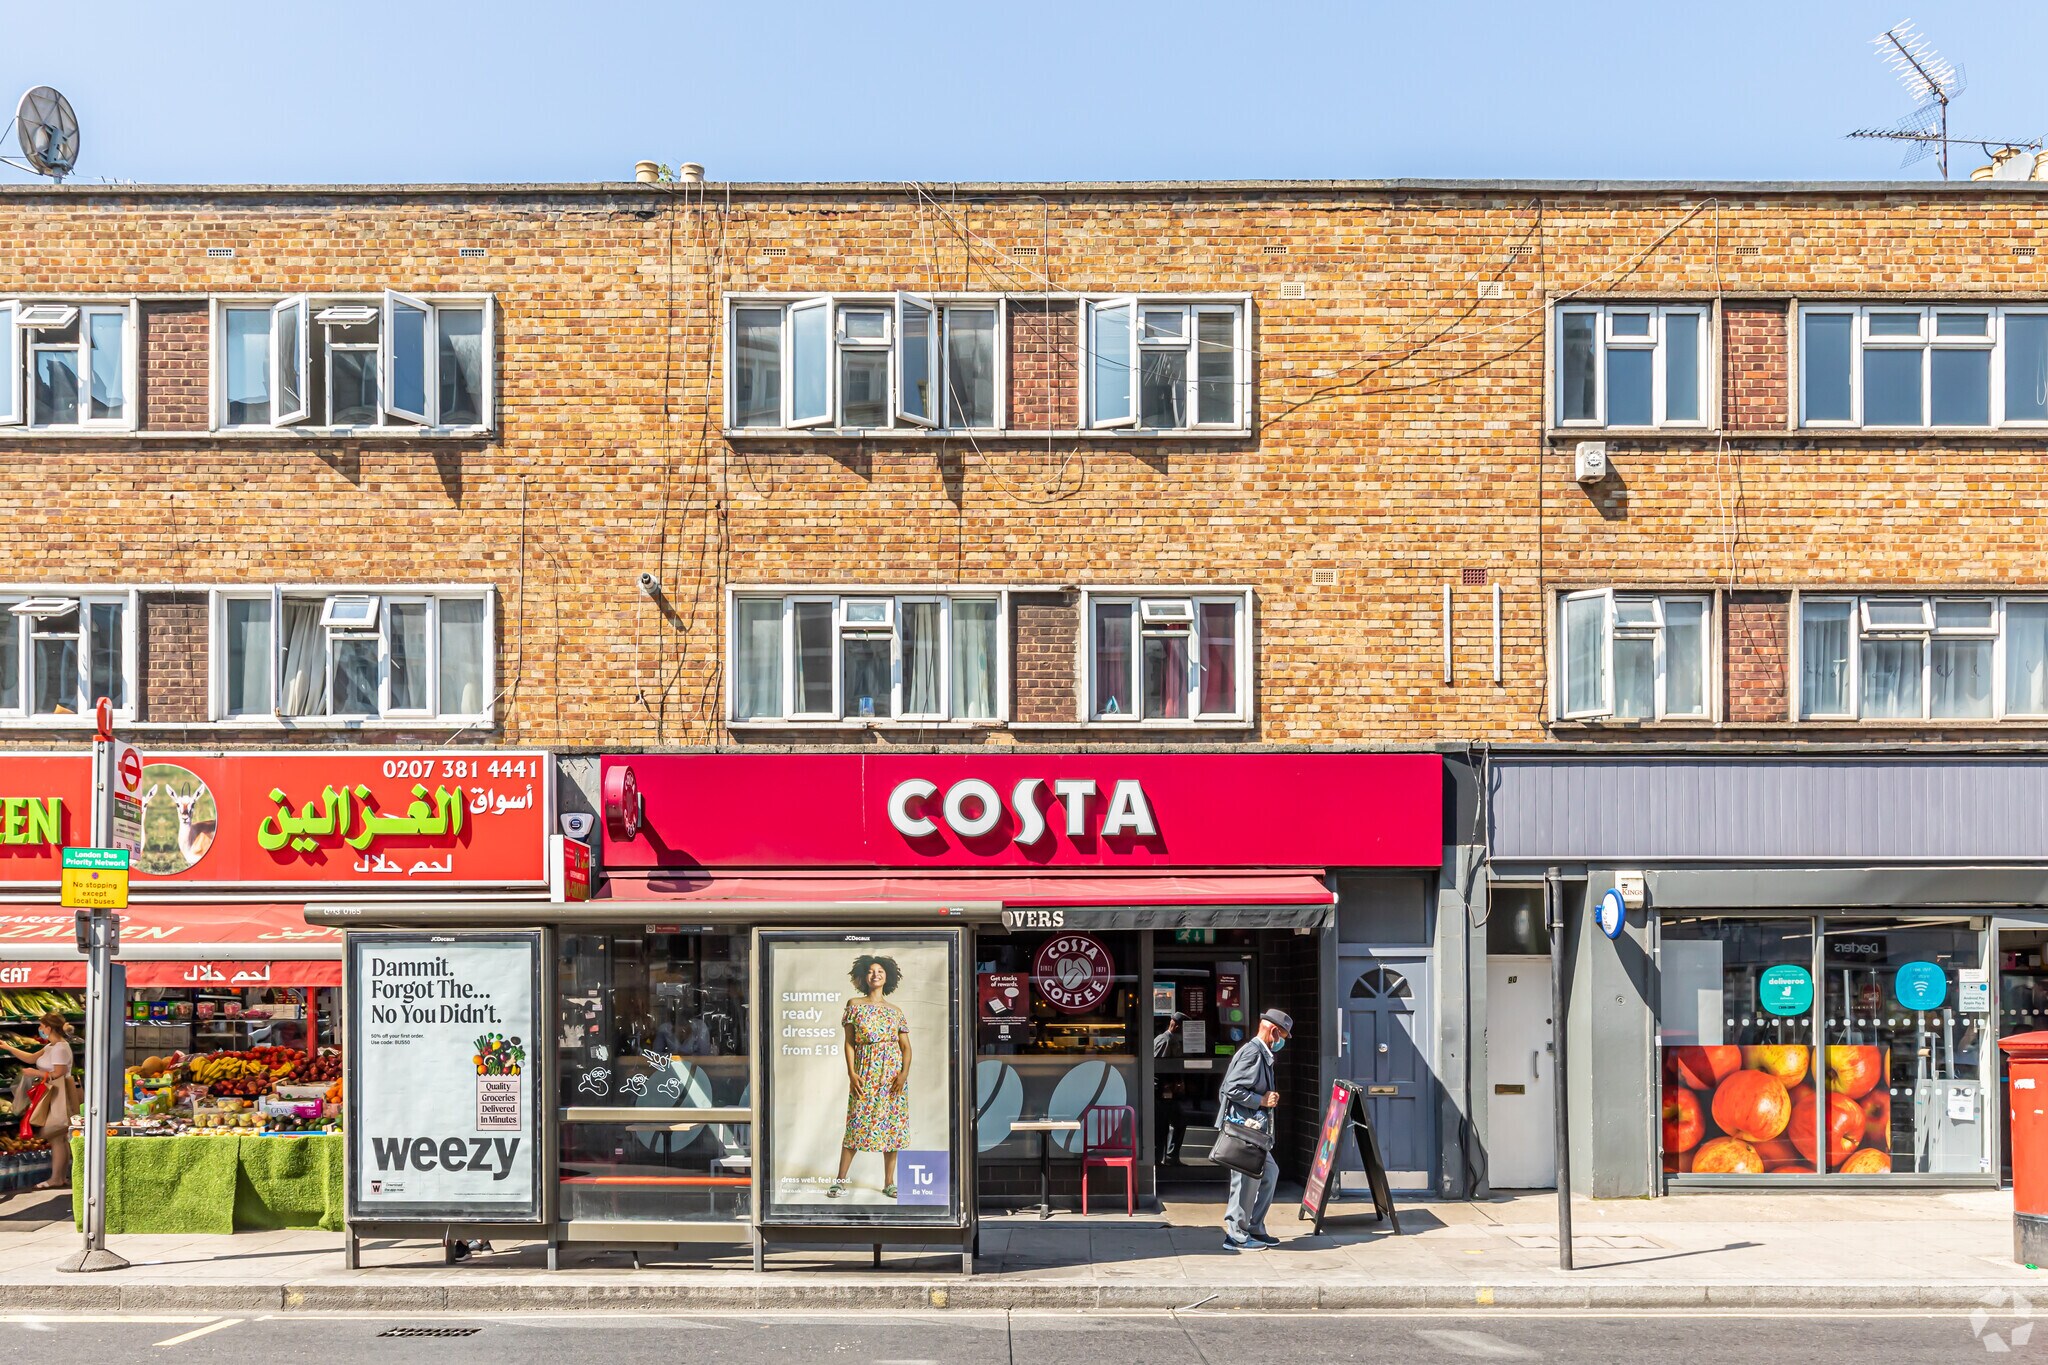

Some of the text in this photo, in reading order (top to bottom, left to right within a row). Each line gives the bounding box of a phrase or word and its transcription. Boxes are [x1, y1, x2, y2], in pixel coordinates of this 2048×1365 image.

[382, 760, 537, 779] 0207 381 4441
[469, 784, 533, 815] أسواق
[0, 797, 63, 845] EN
[887, 778, 1158, 846] COSTA
[65, 858, 126, 867] Priority Network
[75, 850, 118, 859] London Bus
[353, 853, 452, 877] لحم حلال
[1008, 910, 1065, 928] VERS
[1047, 938, 1099, 960] COSTA
[183, 964, 270, 983] لحم حلال
[371, 956, 454, 977] Dammit.
[1508, 975, 1518, 984] 90
[1768, 977, 1805, 985] deliveroo
[371, 978, 490, 1004] Forgot The...
[782, 992, 842, 1002] summer
[1043, 979, 1104, 1006] COFFEE
[371, 1003, 502, 1024] No You Didn't.
[782, 1006, 823, 1023] ready
[782, 1024, 836, 1038] dresses
[782, 1044, 839, 1056] from £18
[486, 1082, 511, 1091] Quality
[481, 1094, 516, 1102] Groceries
[482, 1104, 515, 1112] Delivered
[489, 1115, 517, 1123] Minutes
[371, 1136, 521, 1181] weezy
[781, 1176, 852, 1185] dress well. feel good.
[908, 1164, 933, 1185] Tu
